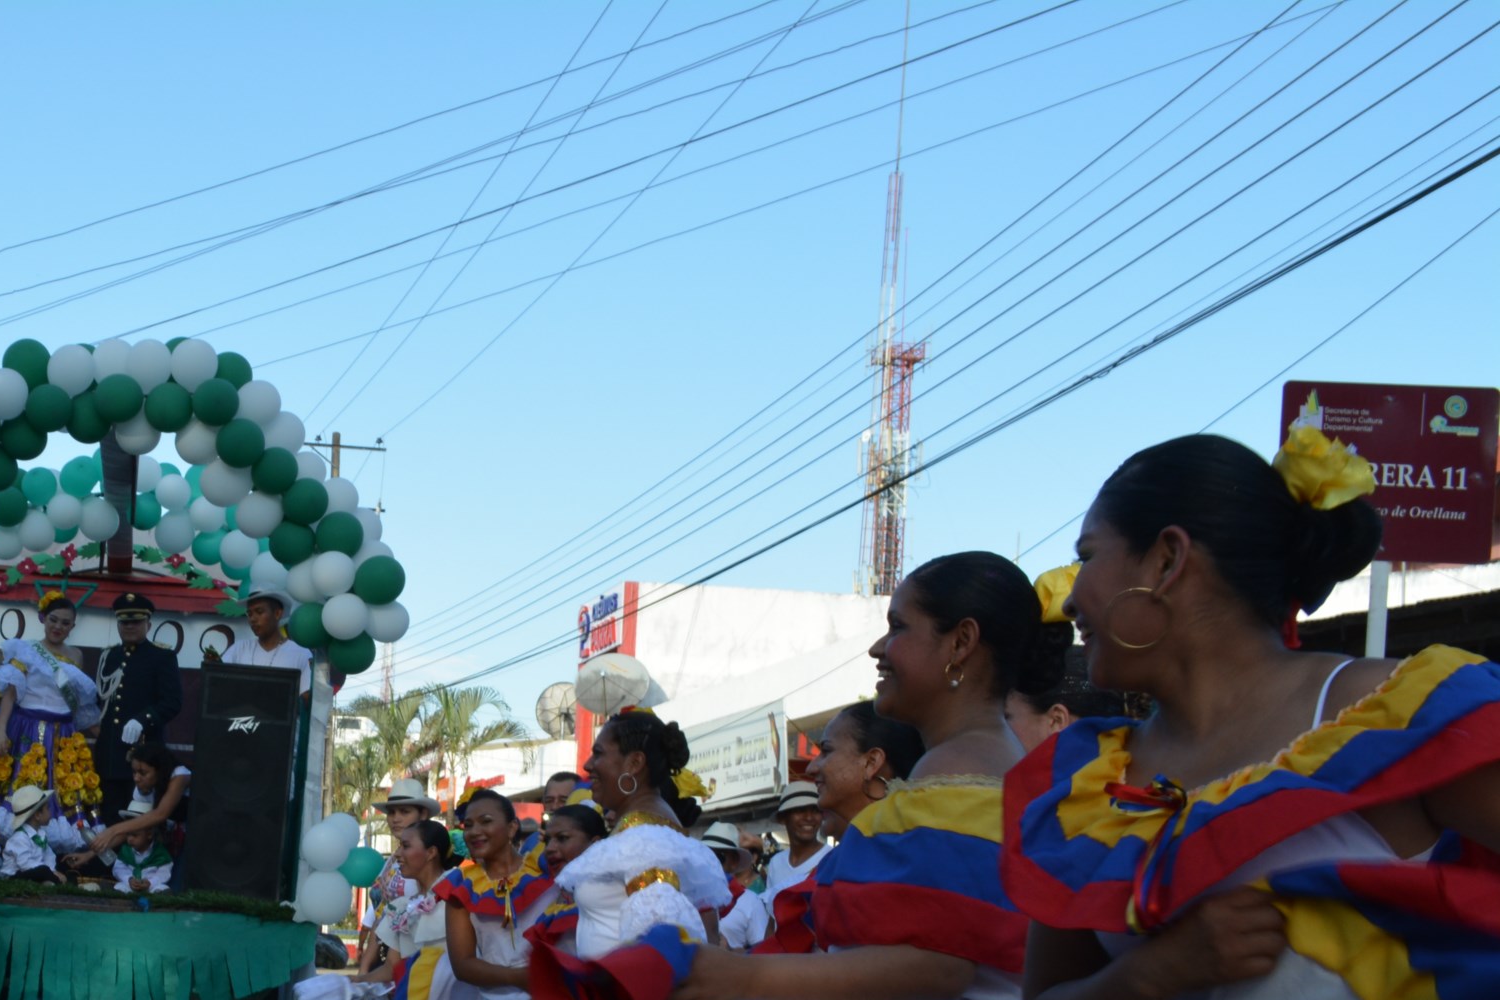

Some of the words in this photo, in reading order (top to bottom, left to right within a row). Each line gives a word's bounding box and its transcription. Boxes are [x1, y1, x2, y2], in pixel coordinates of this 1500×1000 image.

[1324, 415, 1352, 423] Turismo
[1358, 416, 1383, 425] Cultura
[1323, 423, 1373, 432] Departamental
[1368, 462, 1436, 489] RERA
[1442, 466, 1468, 490] 11
[1391, 505, 1407, 518] de
[1409, 506, 1466, 520] Orellana
